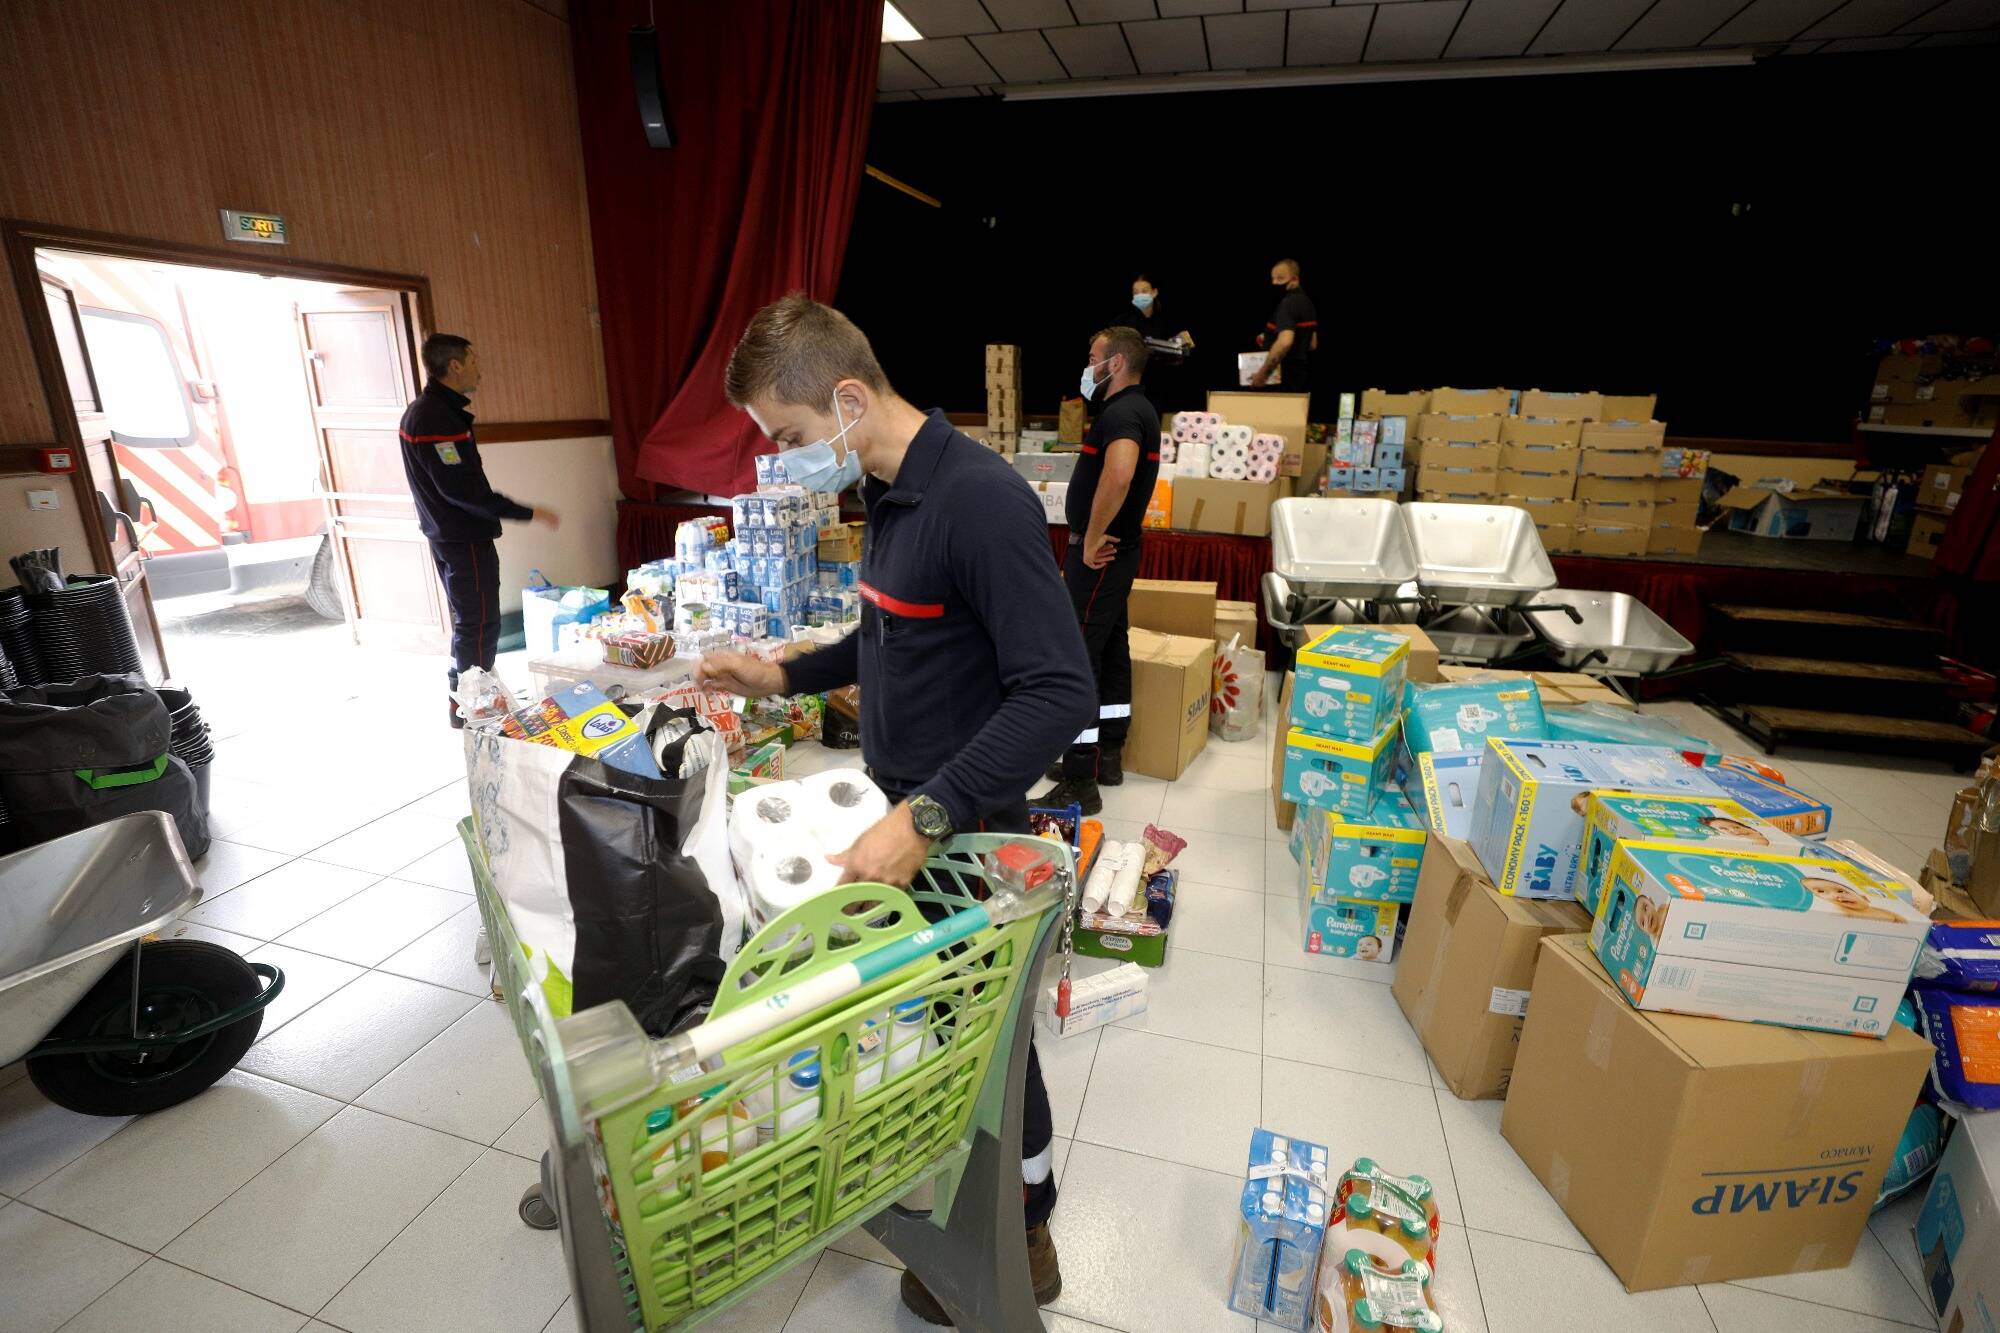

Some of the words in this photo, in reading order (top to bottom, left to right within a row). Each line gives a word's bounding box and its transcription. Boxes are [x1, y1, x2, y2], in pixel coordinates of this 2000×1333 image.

[589, 718, 613, 733] Lotus
[1519, 800, 1530, 815] 160
[1513, 824, 1526, 846] PACK
[1503, 847, 1521, 890] ECONOMY
[1529, 843, 1559, 892] BABY
[1709, 864, 1784, 883] Pampers
[1326, 916, 1365, 933] Pampers
[1610, 910, 1632, 961] Pampers
[1820, 1145, 1875, 1160] Monaco
[1691, 1171, 1864, 1215] SIAMP
